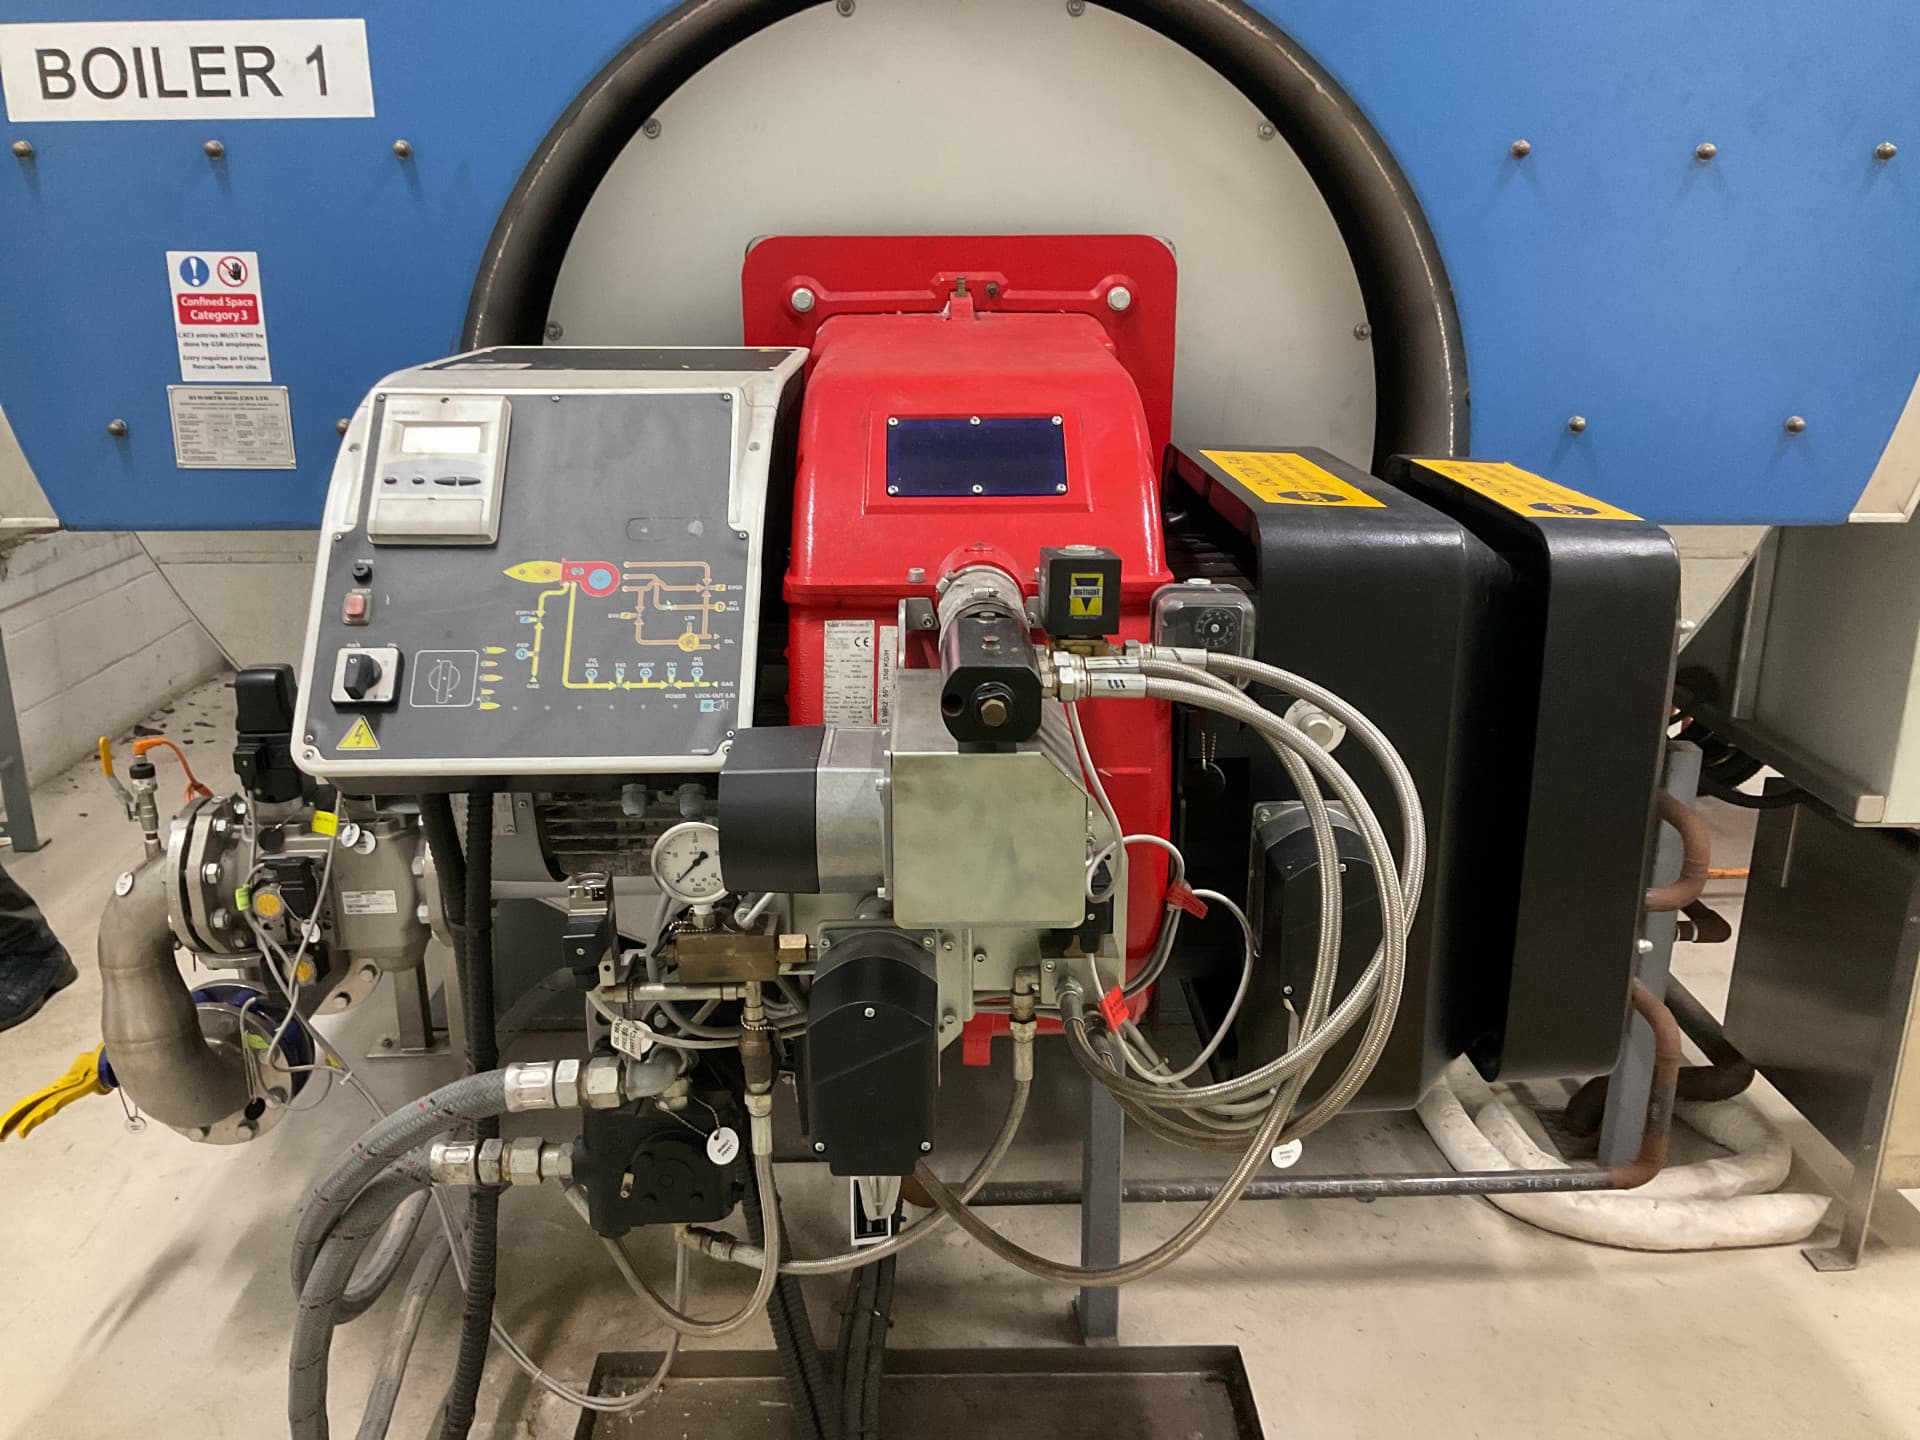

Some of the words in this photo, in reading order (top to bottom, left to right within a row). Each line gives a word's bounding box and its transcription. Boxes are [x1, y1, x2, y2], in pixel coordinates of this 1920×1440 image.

[35, 46, 284, 100] BOILER
[305, 44, 328, 97] 1
[180, 296, 224, 307] Confined
[225, 296, 254, 308] Space
[190, 309, 239, 322] Category
[240, 310, 248, 320] 3
[854, 636, 870, 648] CE
